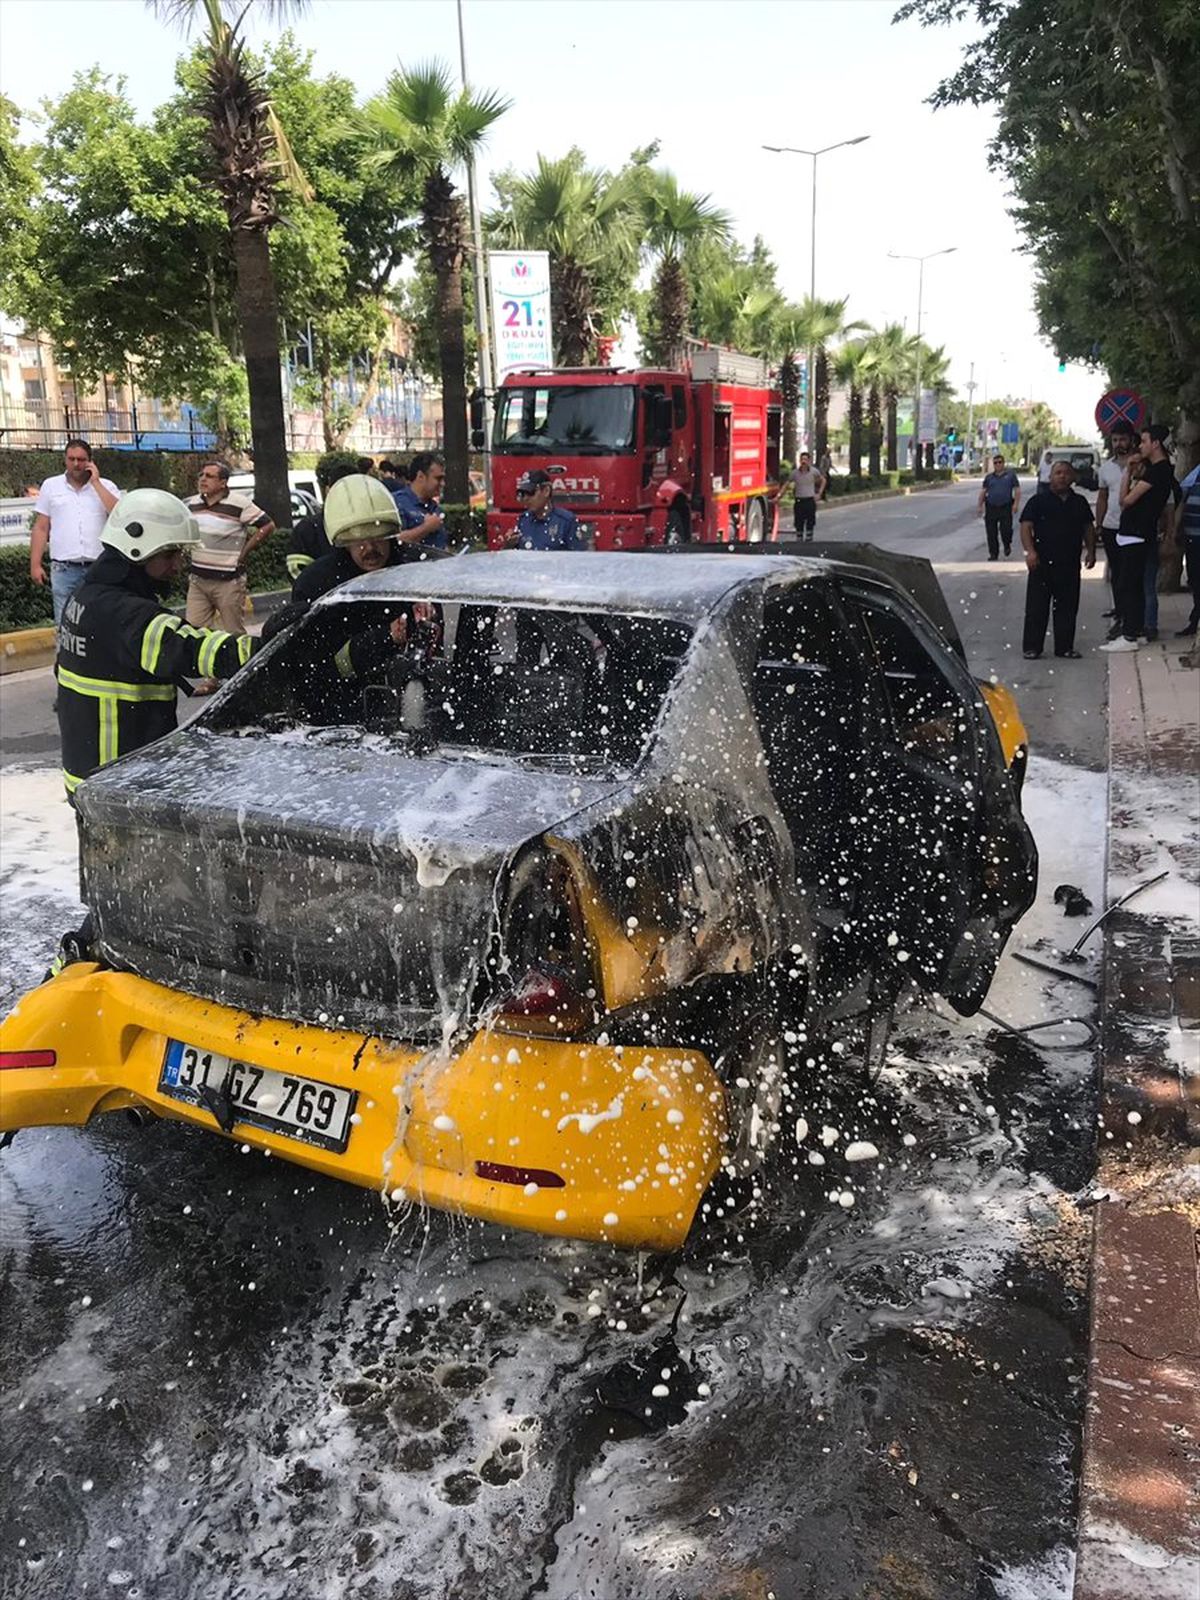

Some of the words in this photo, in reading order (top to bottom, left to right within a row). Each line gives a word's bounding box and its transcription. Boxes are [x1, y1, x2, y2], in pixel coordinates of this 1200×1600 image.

[167, 1065, 178, 1078] TR
[180, 1048, 212, 1087] 31
[228, 1062, 265, 1109] GZ
[277, 1076, 337, 1131] 769
